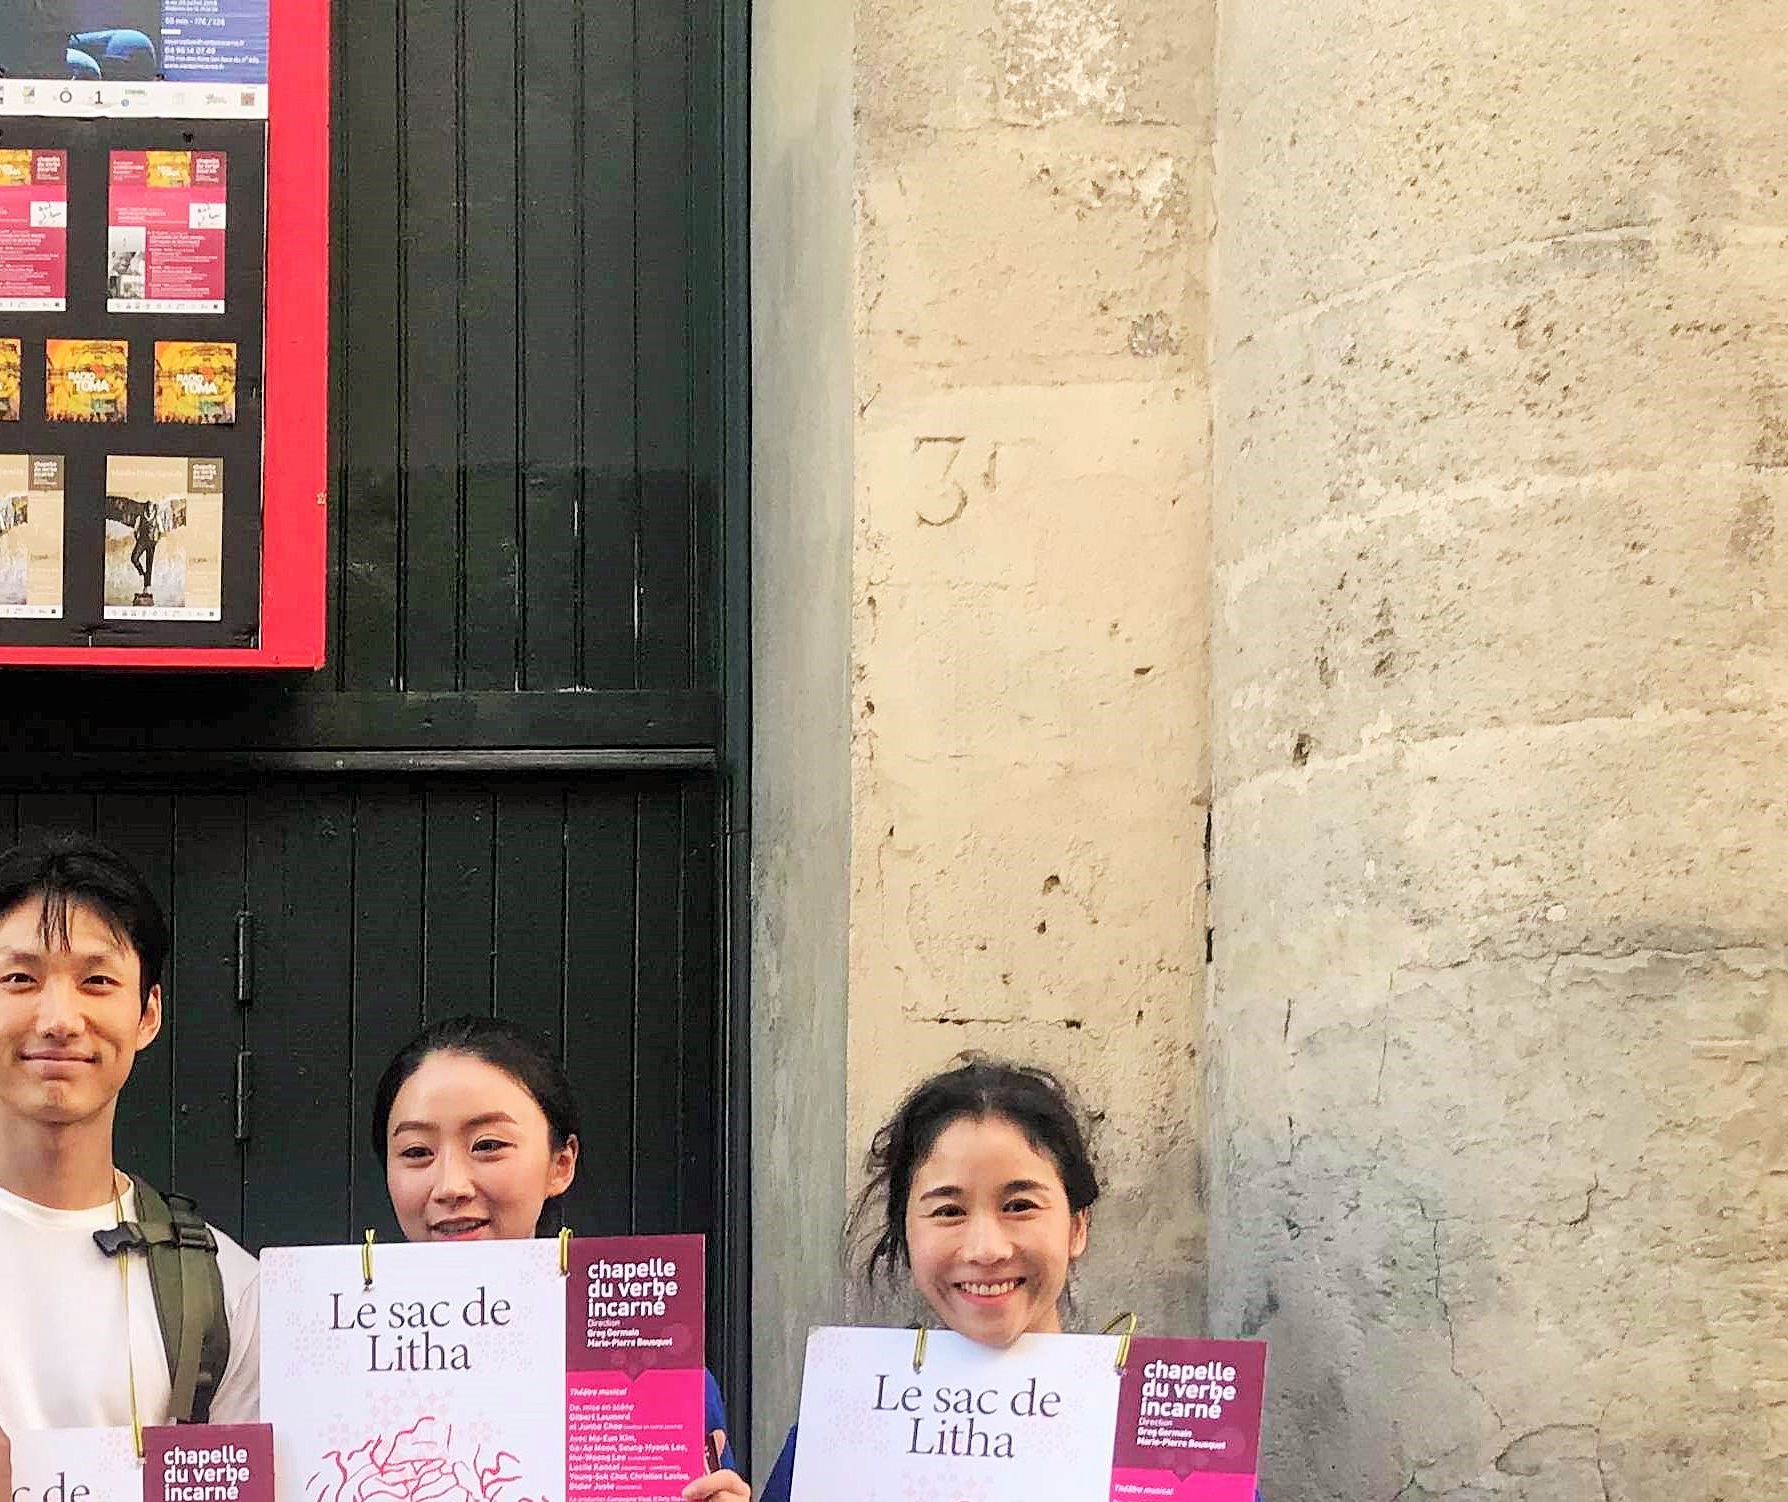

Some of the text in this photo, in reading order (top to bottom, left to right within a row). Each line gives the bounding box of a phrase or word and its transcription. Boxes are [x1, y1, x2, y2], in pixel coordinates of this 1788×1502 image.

[75, 379, 110, 393] TOMA
[183, 381, 218, 395] TOMA
[586, 1257, 676, 1283] chapelle
[587, 1276, 678, 1298] du verbe
[328, 1285, 511, 1330] Le sac de
[588, 1295, 666, 1317] incarné
[366, 1330, 472, 1372] Litha
[1141, 1358, 1237, 1385] chapelle
[871, 1373, 1062, 1418] Le sac de
[1141, 1377, 1237, 1401] du verbe
[1139, 1395, 1223, 1419] incarné
[906, 1414, 1018, 1459] Litha
[163, 1444, 248, 1469] chapelle
[163, 1462, 250, 1483] du verbe
[164, 1480, 239, 1502] incarné
